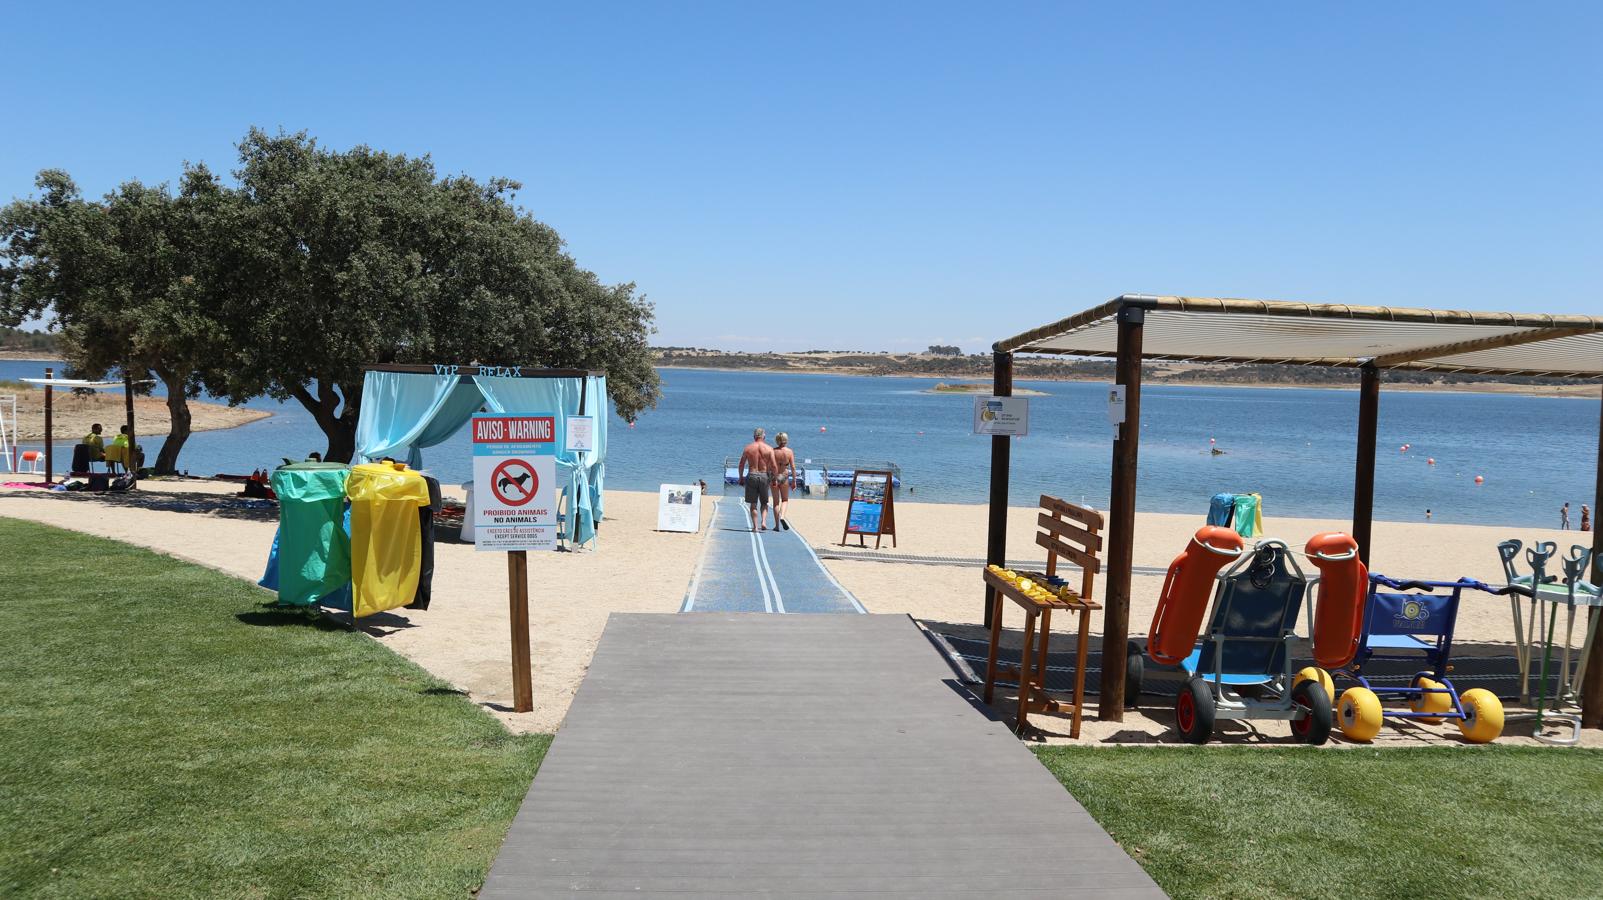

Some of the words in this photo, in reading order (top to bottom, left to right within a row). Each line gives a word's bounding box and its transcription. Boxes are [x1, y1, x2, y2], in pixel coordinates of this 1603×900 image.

[479, 366, 521, 377] RELAX
[477, 421, 503, 440] AVISO
[508, 420, 551, 440] WARNING
